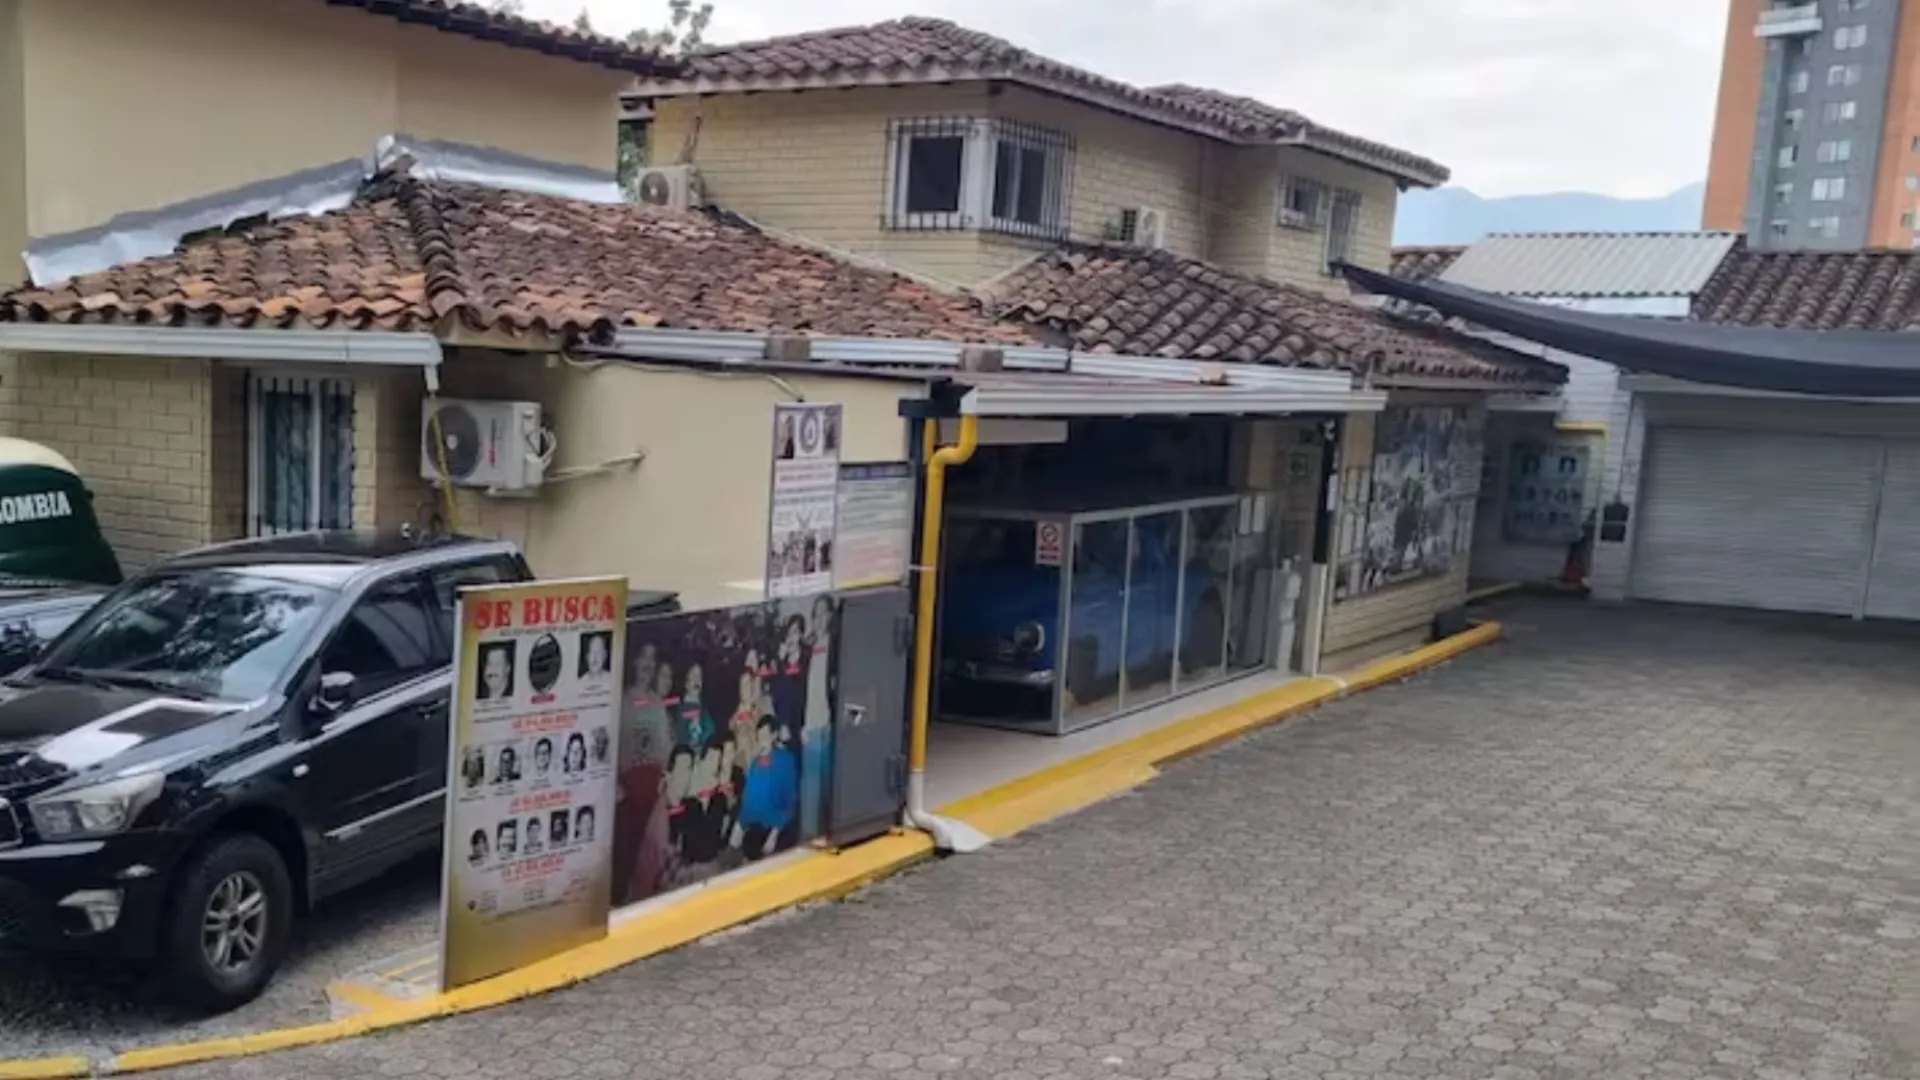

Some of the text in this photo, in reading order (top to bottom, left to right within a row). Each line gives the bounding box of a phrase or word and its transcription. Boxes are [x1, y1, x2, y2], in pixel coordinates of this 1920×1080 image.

[0, 491, 72, 524] OMBIA
[474, 594, 615, 629] SE BUSCA
